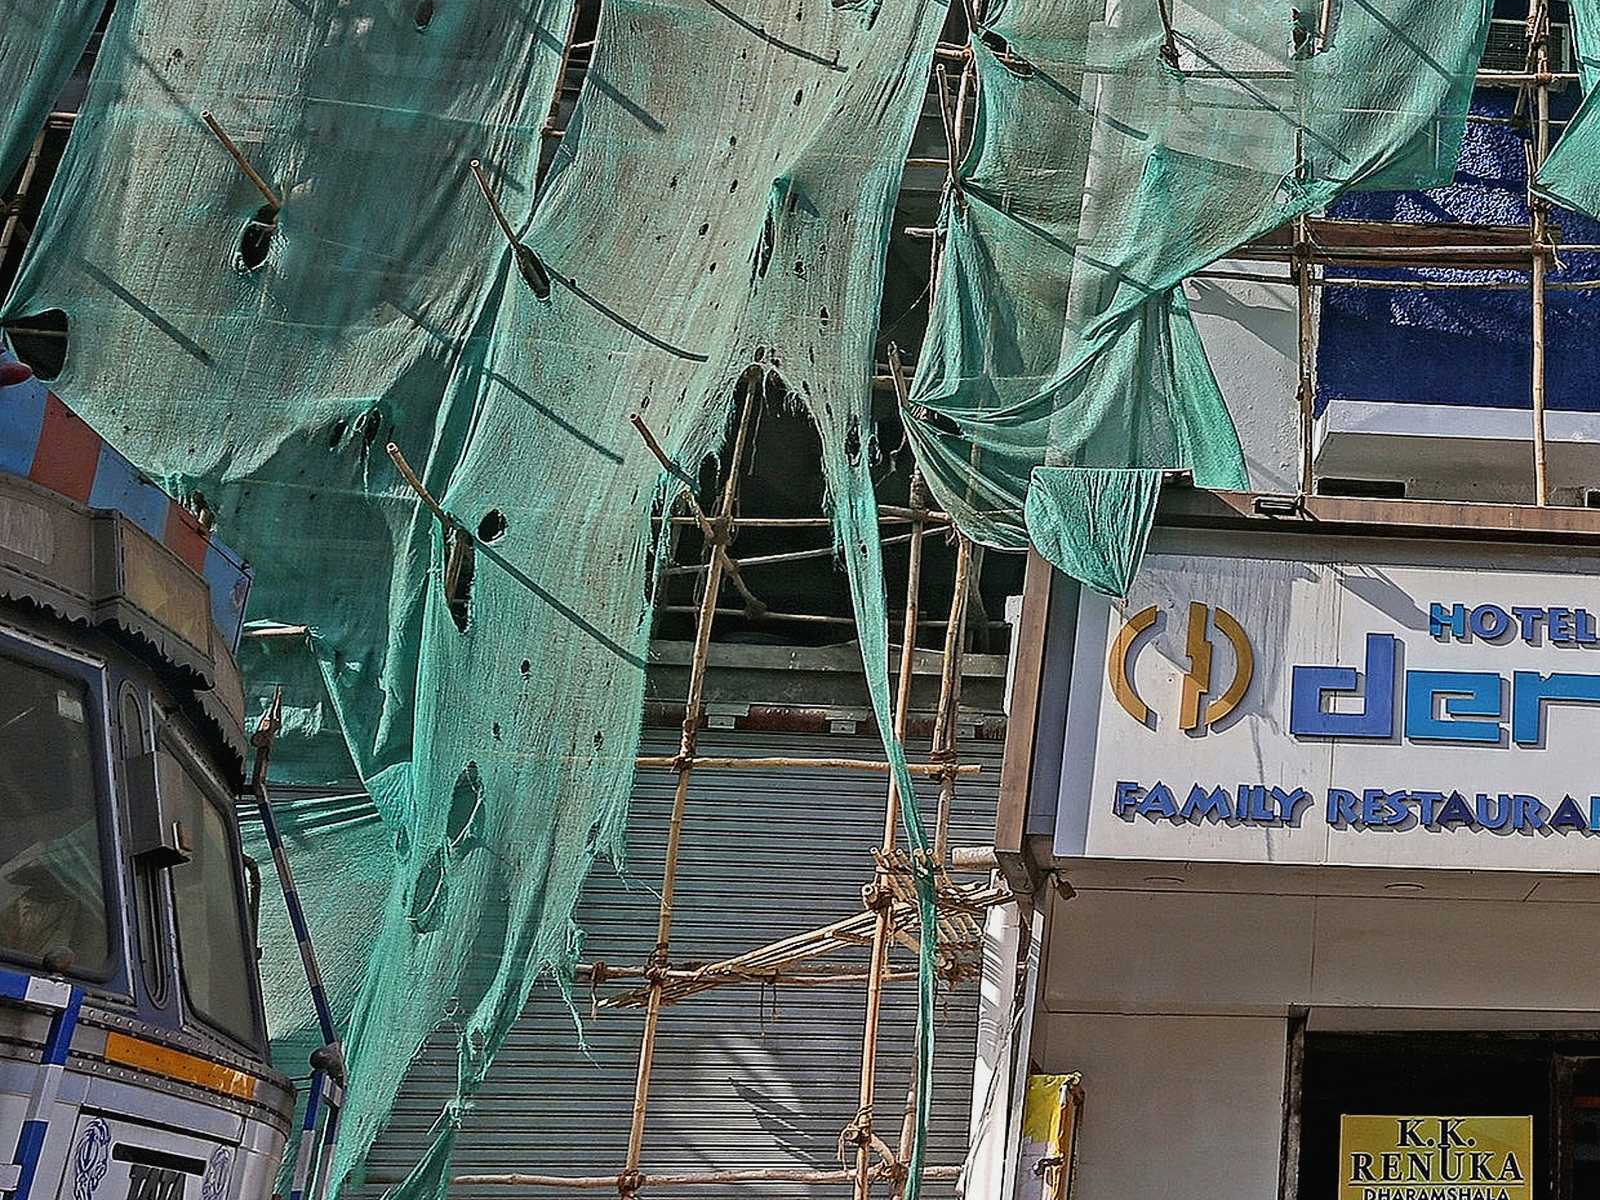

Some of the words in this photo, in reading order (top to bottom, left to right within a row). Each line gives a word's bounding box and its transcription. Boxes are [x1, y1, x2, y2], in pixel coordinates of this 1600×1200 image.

[1428, 603, 1600, 643] HOTEL
[1114, 780, 1308, 823] FAMILY
[1396, 1118, 1477, 1147] K.K.
[1350, 1145, 1525, 1182] RENUKA
